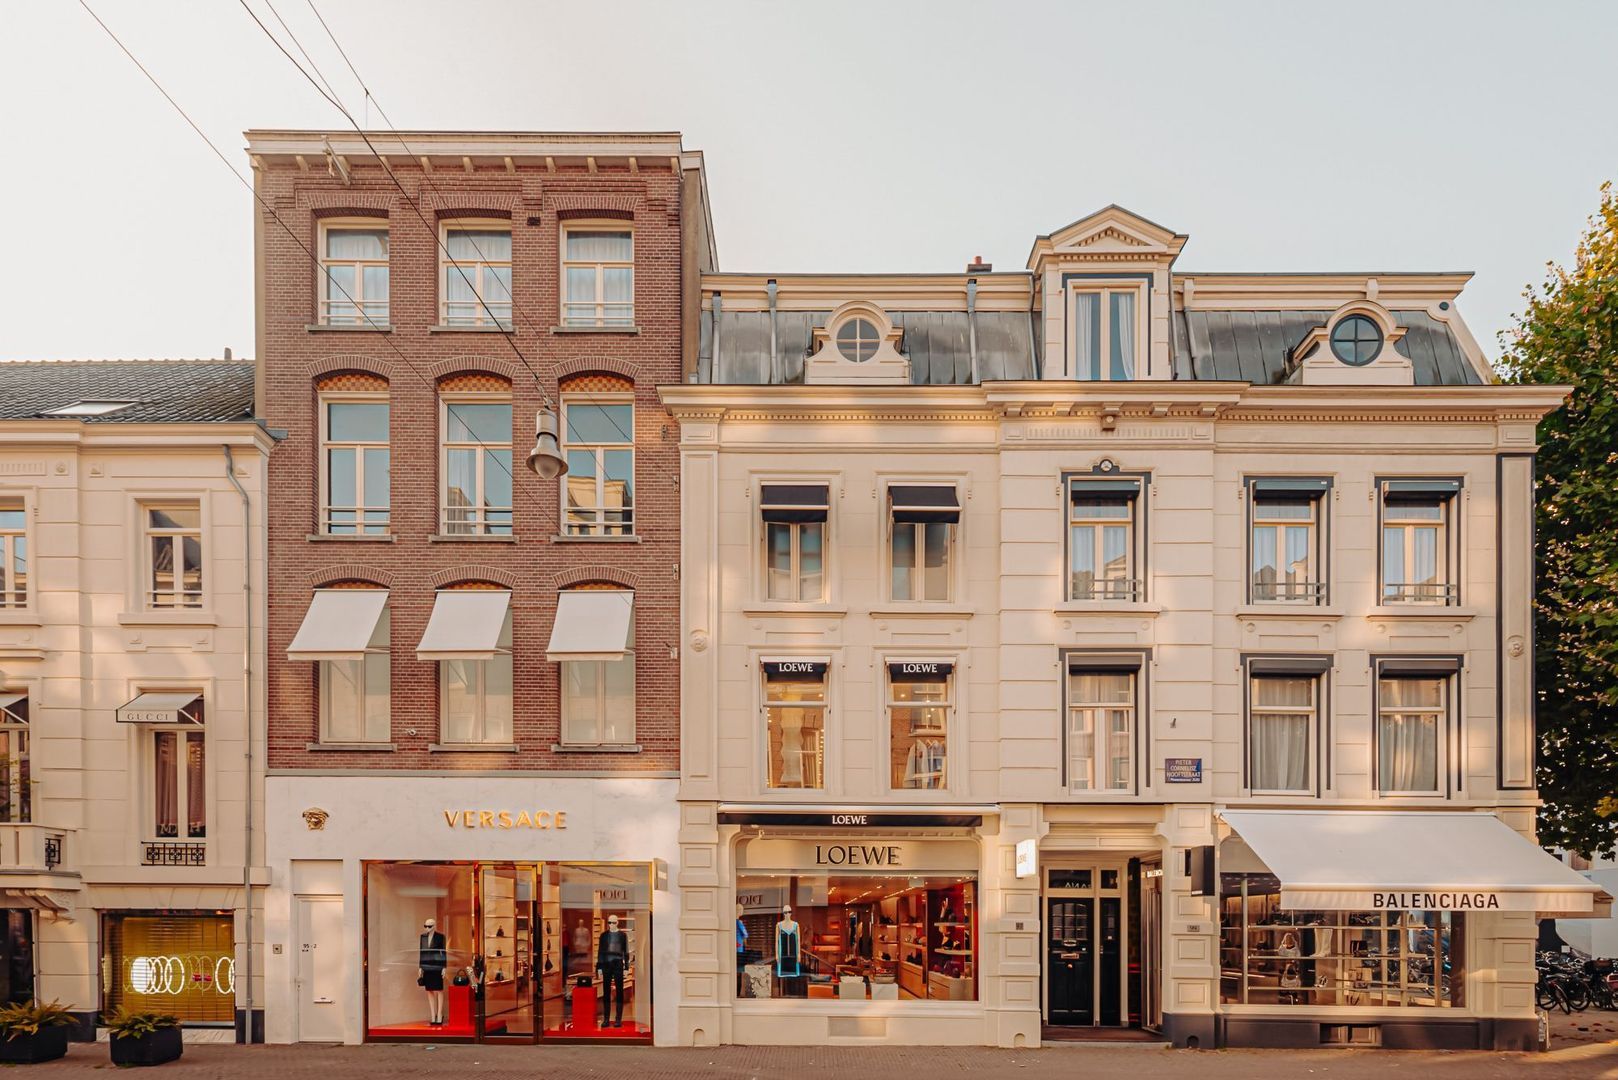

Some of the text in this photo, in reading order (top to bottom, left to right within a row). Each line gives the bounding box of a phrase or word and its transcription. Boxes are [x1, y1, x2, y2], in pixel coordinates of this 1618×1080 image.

[779, 663, 813, 672] LOEWE
[903, 664, 938, 673] LOEWE
[444, 810, 567, 829] VERSACE
[832, 815, 867, 824] LOEWE
[816, 845, 901, 865] LOEWE
[1373, 893, 1499, 909] BALENCIAGA
